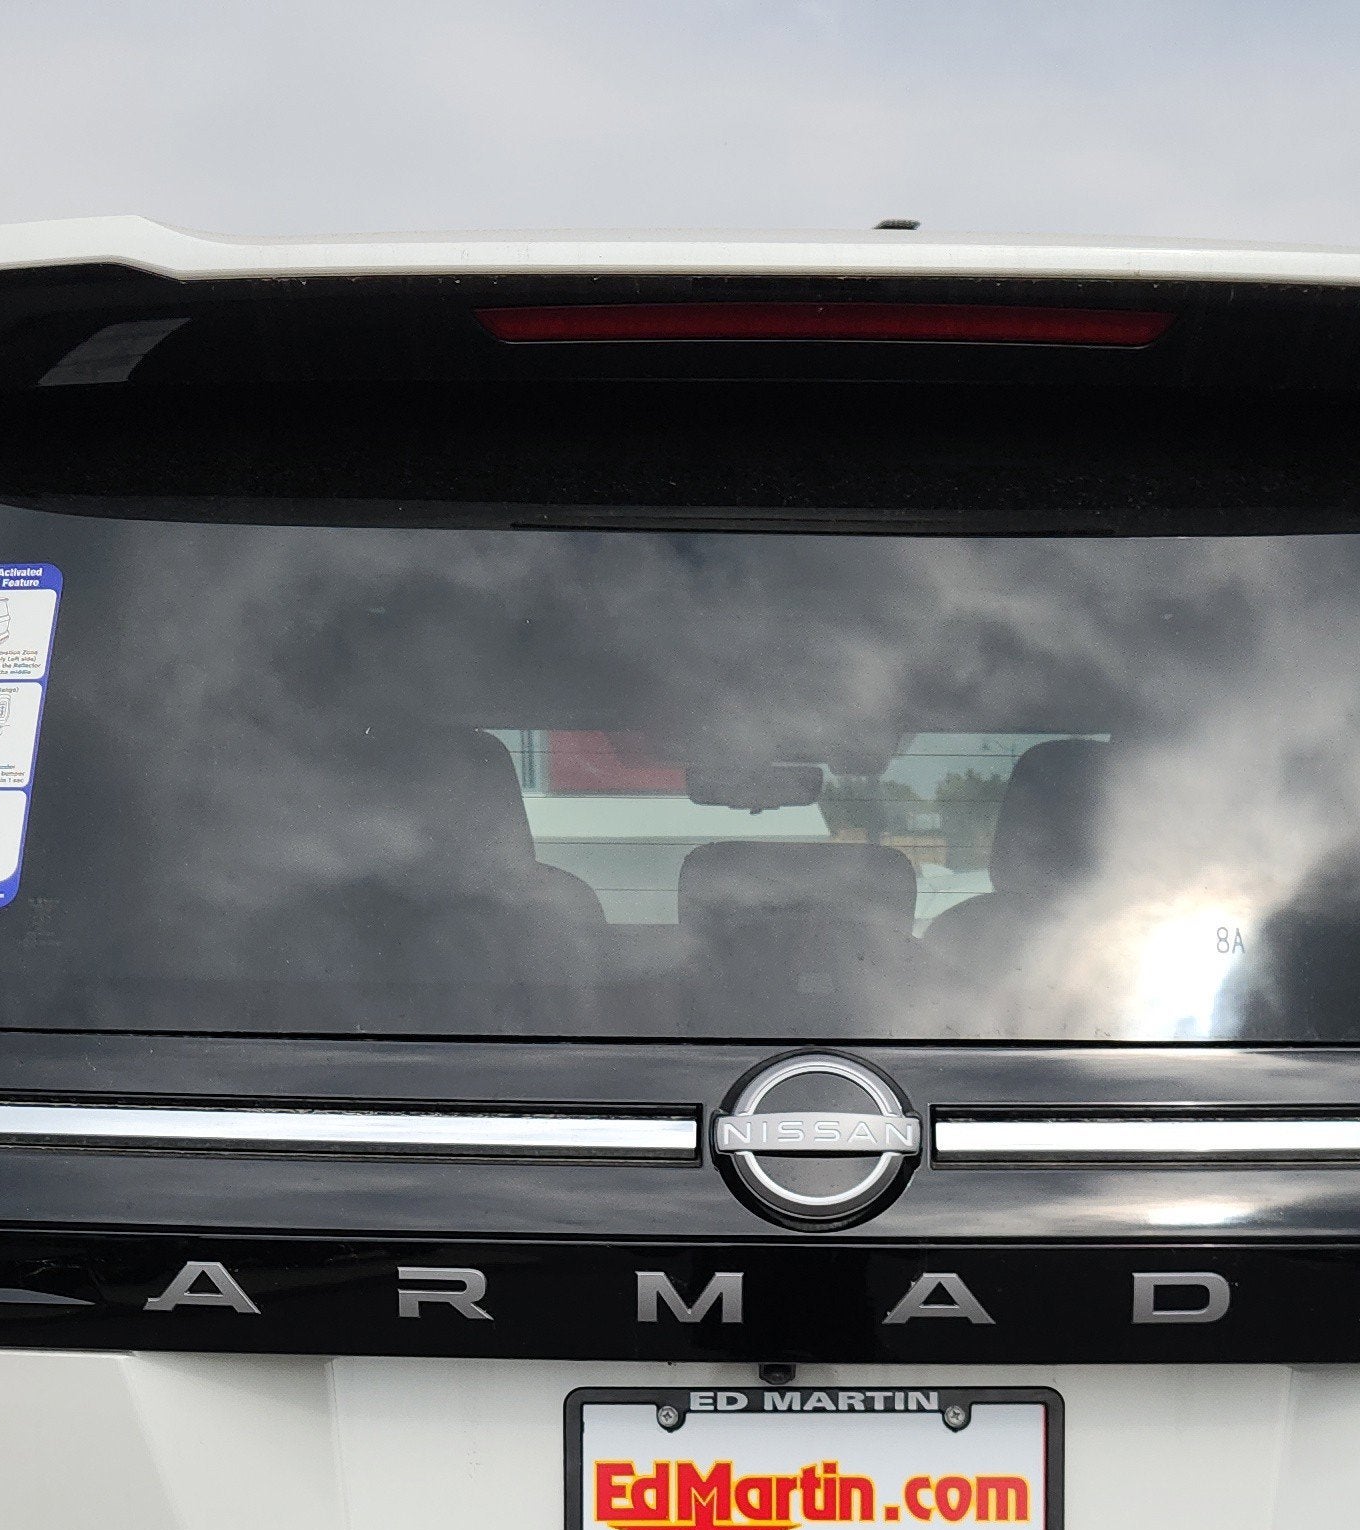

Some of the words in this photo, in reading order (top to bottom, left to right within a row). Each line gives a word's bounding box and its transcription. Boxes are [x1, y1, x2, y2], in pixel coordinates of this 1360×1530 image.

[2, 579, 39, 587] Feature
[722, 1120, 914, 1147] NISSAN
[689, 1391, 758, 1411] ED
[763, 1391, 938, 1411] MARTIN
[594, 1459, 1031, 1524] EdMartin.com
